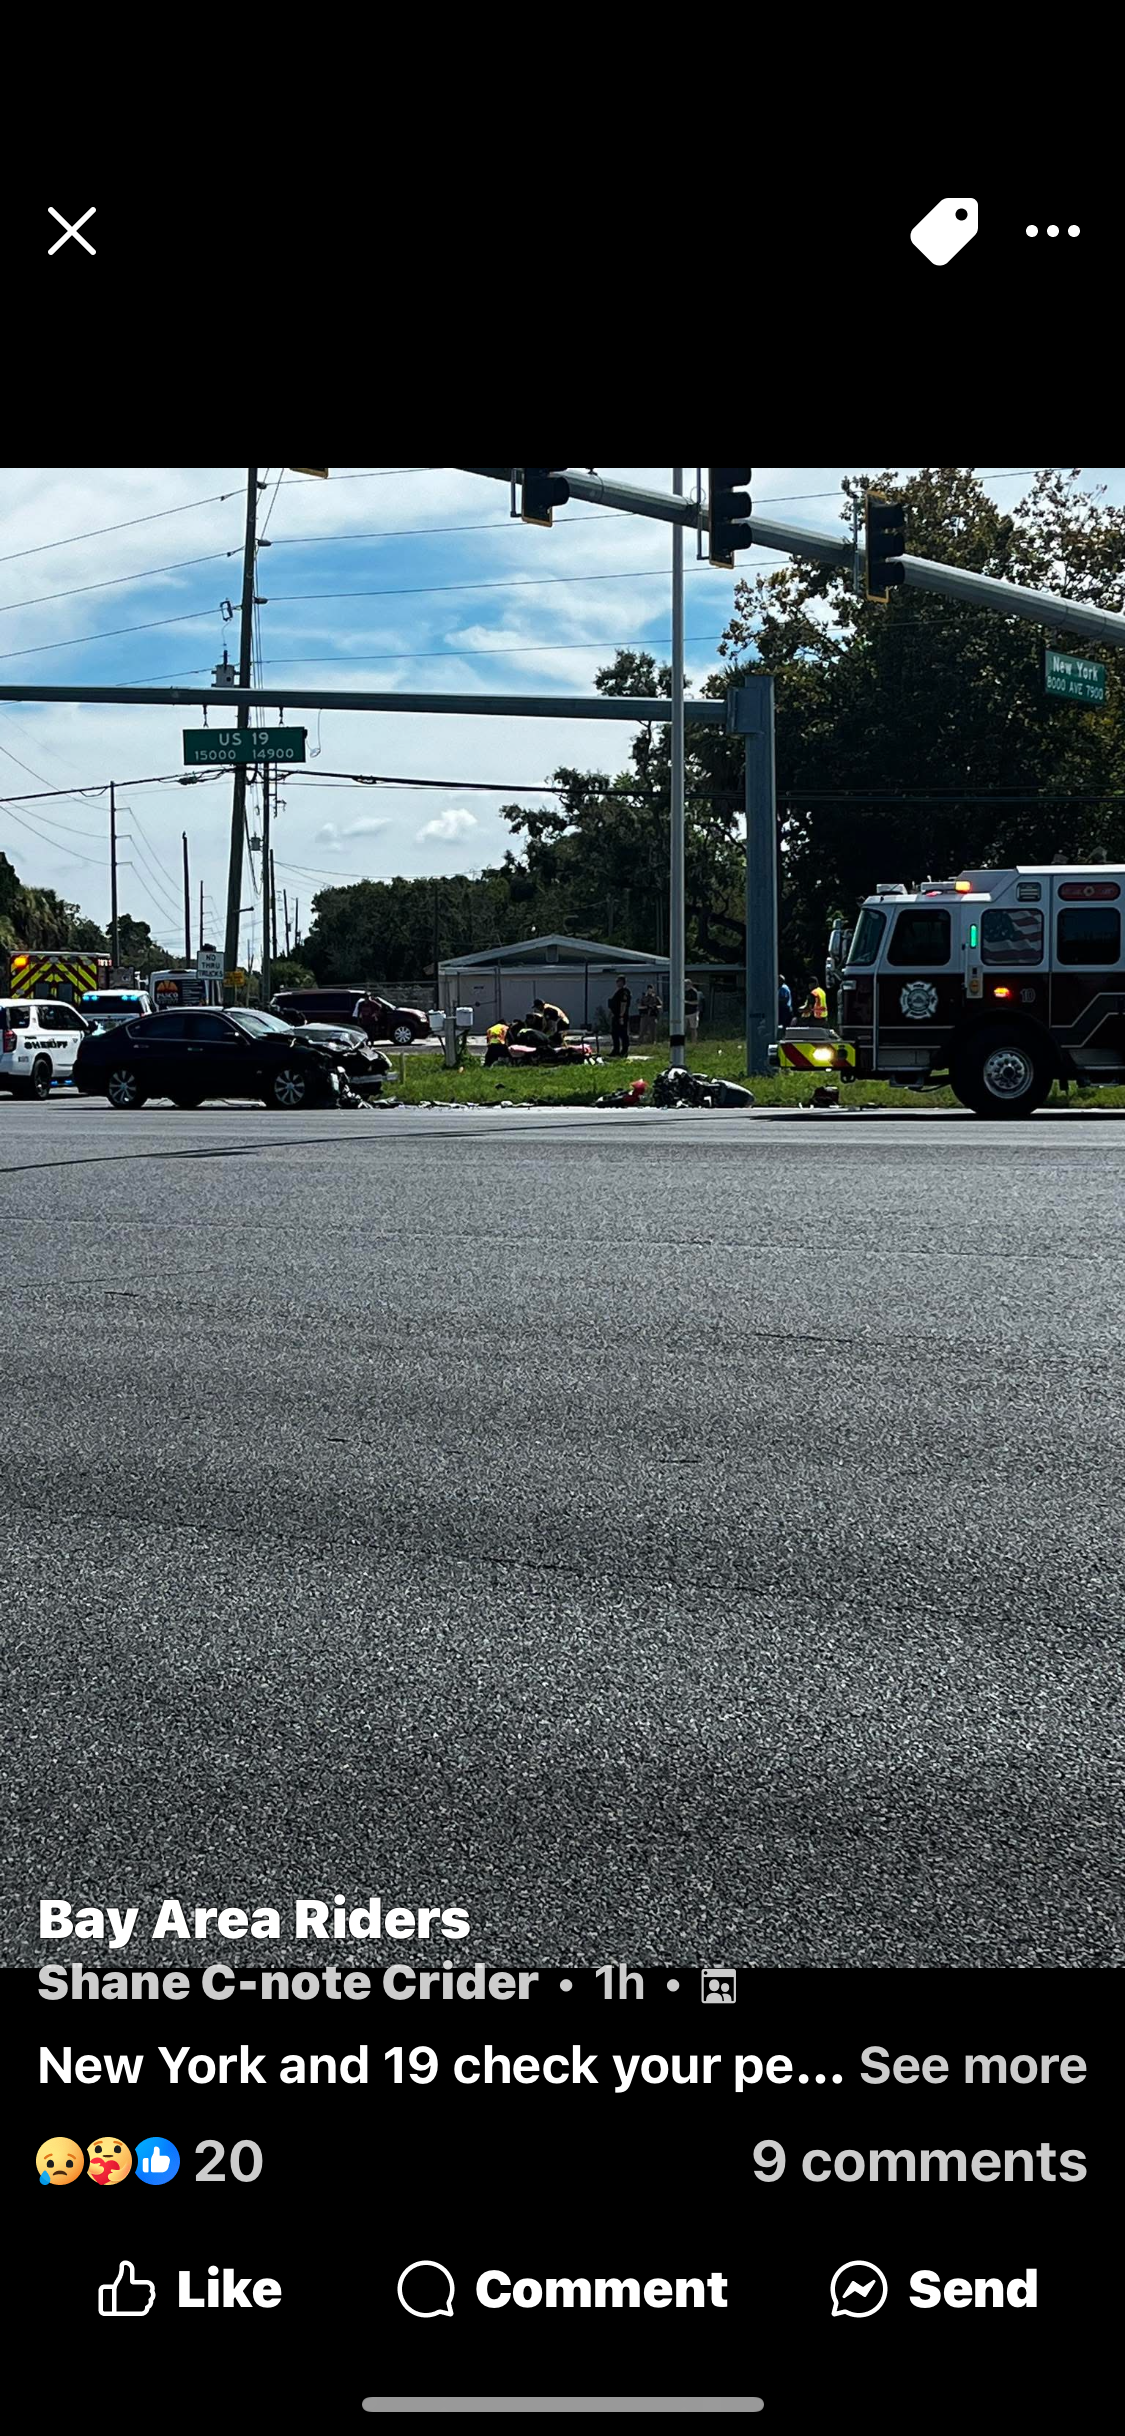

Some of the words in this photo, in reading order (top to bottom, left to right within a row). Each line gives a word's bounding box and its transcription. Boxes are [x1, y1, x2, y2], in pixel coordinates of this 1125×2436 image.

[1053, 656, 1072, 675] New
[1076, 662, 1098, 681] York
[1047, 676, 1066, 691] 8000
[1069, 681, 1084, 695] AVE
[1086, 685, 1104, 700] 7900
[219, 733, 242, 745] US
[252, 732, 269, 746] 19
[195, 749, 236, 760] 15000
[252, 748, 294, 759] 14900
[1020, 988, 1036, 1003] 10
